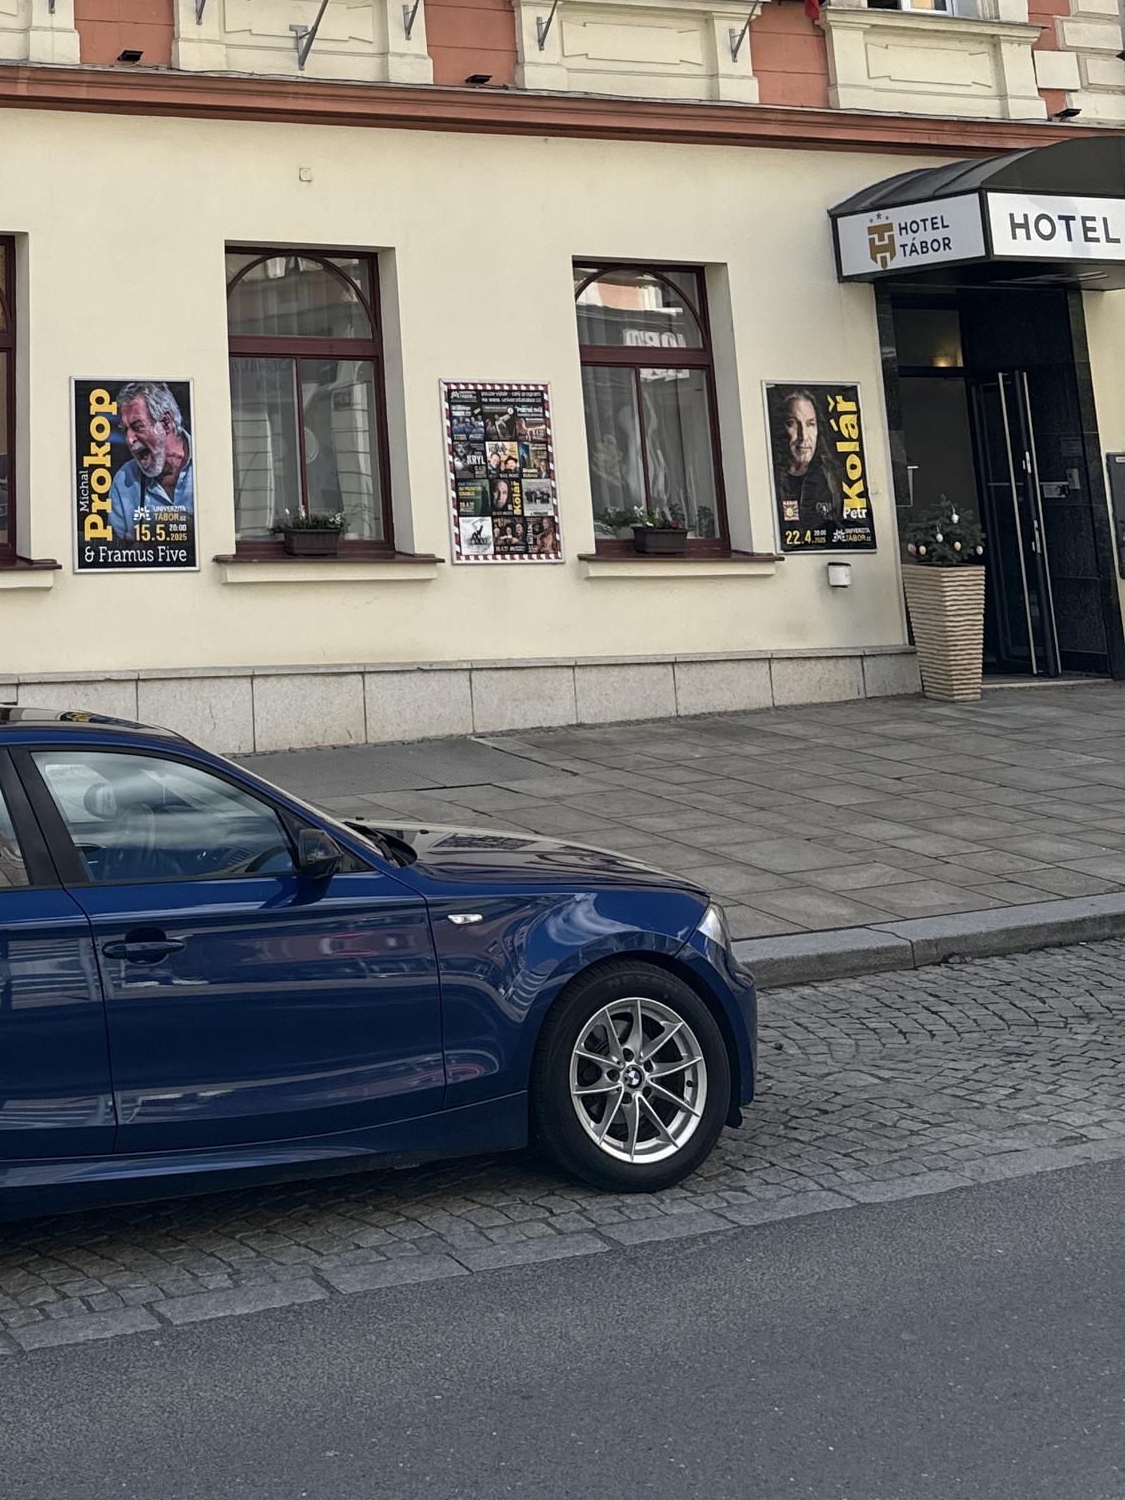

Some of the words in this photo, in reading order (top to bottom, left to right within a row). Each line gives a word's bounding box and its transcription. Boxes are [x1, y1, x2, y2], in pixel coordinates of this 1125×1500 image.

[898, 215, 949, 237] HOTEL
[1009, 212, 1121, 244] HOTEL
[900, 236, 952, 258] TÁBOR
[467, 455, 486, 465] KRYL
[826, 395, 867, 509] Kolář
[83, 388, 118, 541] Prokop
[79, 470, 90, 512] Michal
[511, 480, 522, 515] Kolář
[843, 507, 867, 519] Petr
[133, 524, 170, 541] 15.5.
[169, 524, 187, 532] 20:00
[170, 533, 187, 541] 2025
[785, 530, 815, 545] 22.4.
[84, 546, 95, 562] &
[99, 546, 154, 562] Framus
[157, 546, 187, 562] Five
